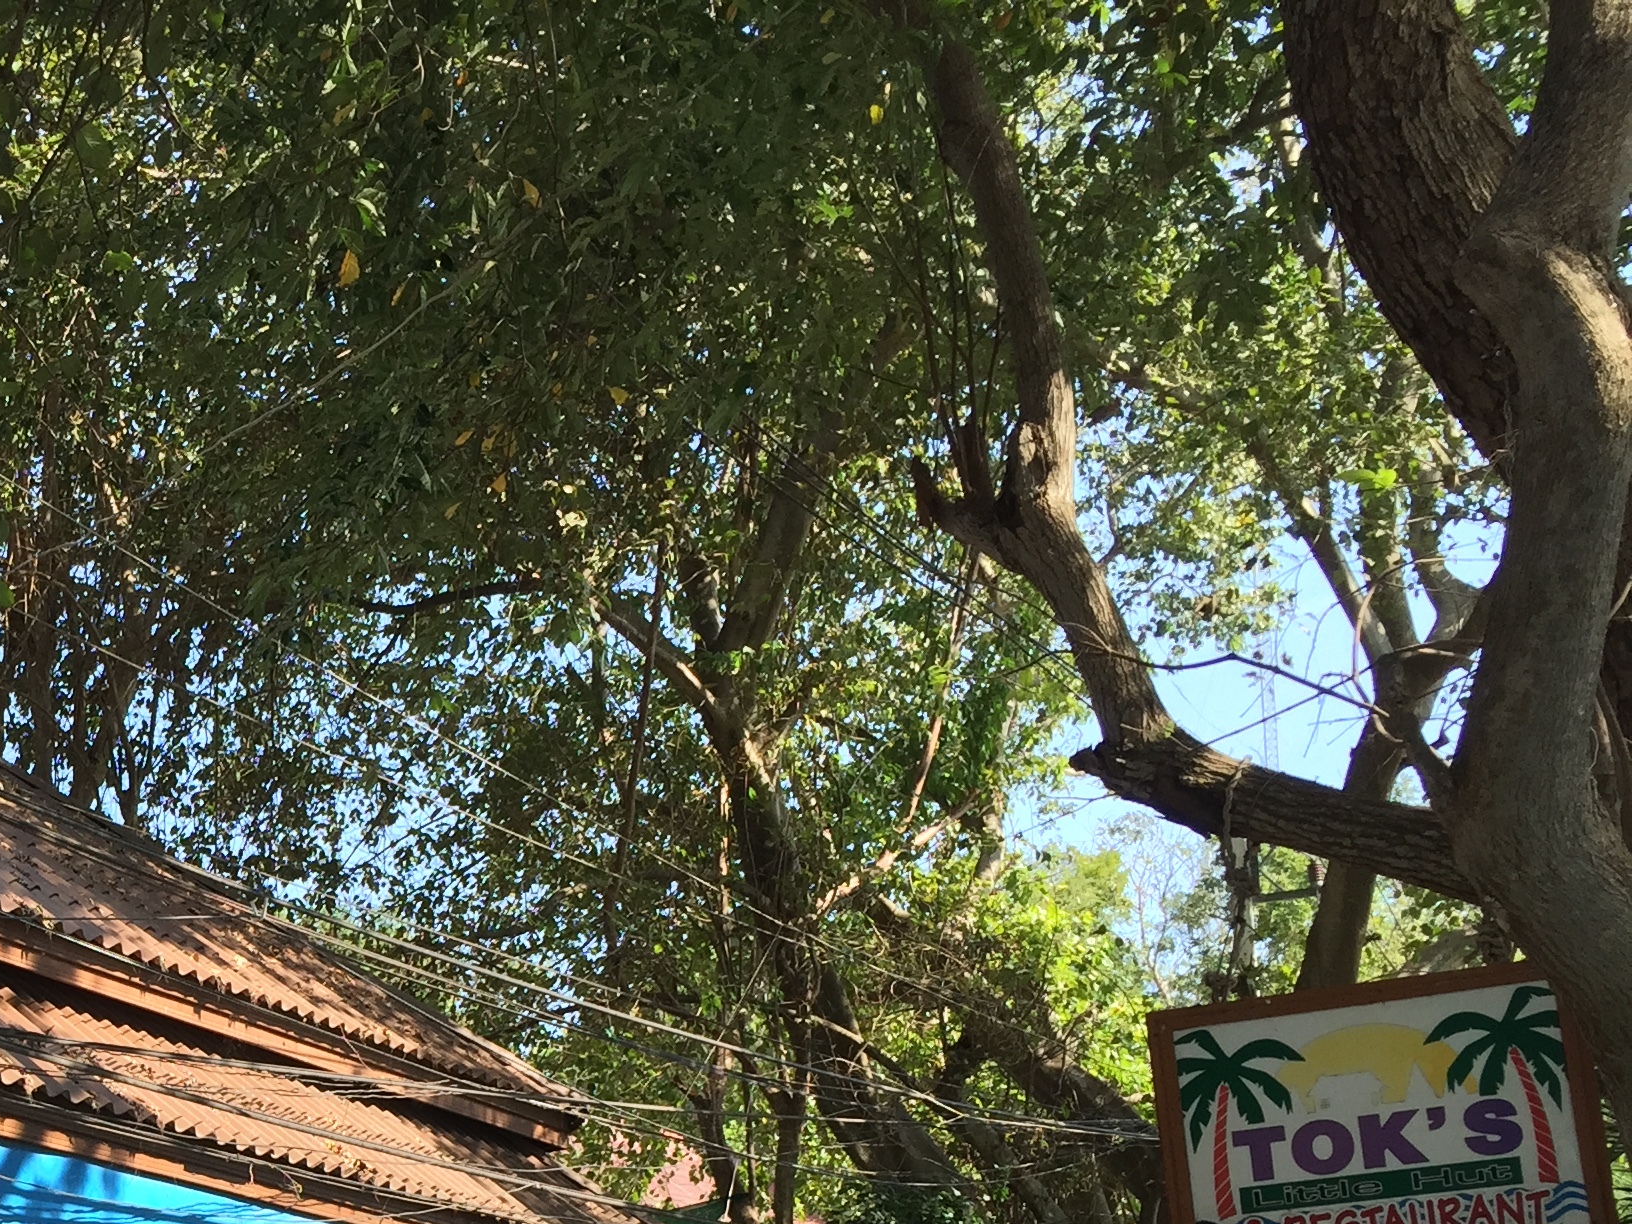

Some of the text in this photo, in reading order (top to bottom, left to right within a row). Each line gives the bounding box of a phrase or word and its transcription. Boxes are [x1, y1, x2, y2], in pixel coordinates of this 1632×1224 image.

[1231, 1098, 1524, 1182] TOK'S
[1251, 1163, 1513, 1208] Little Hut
